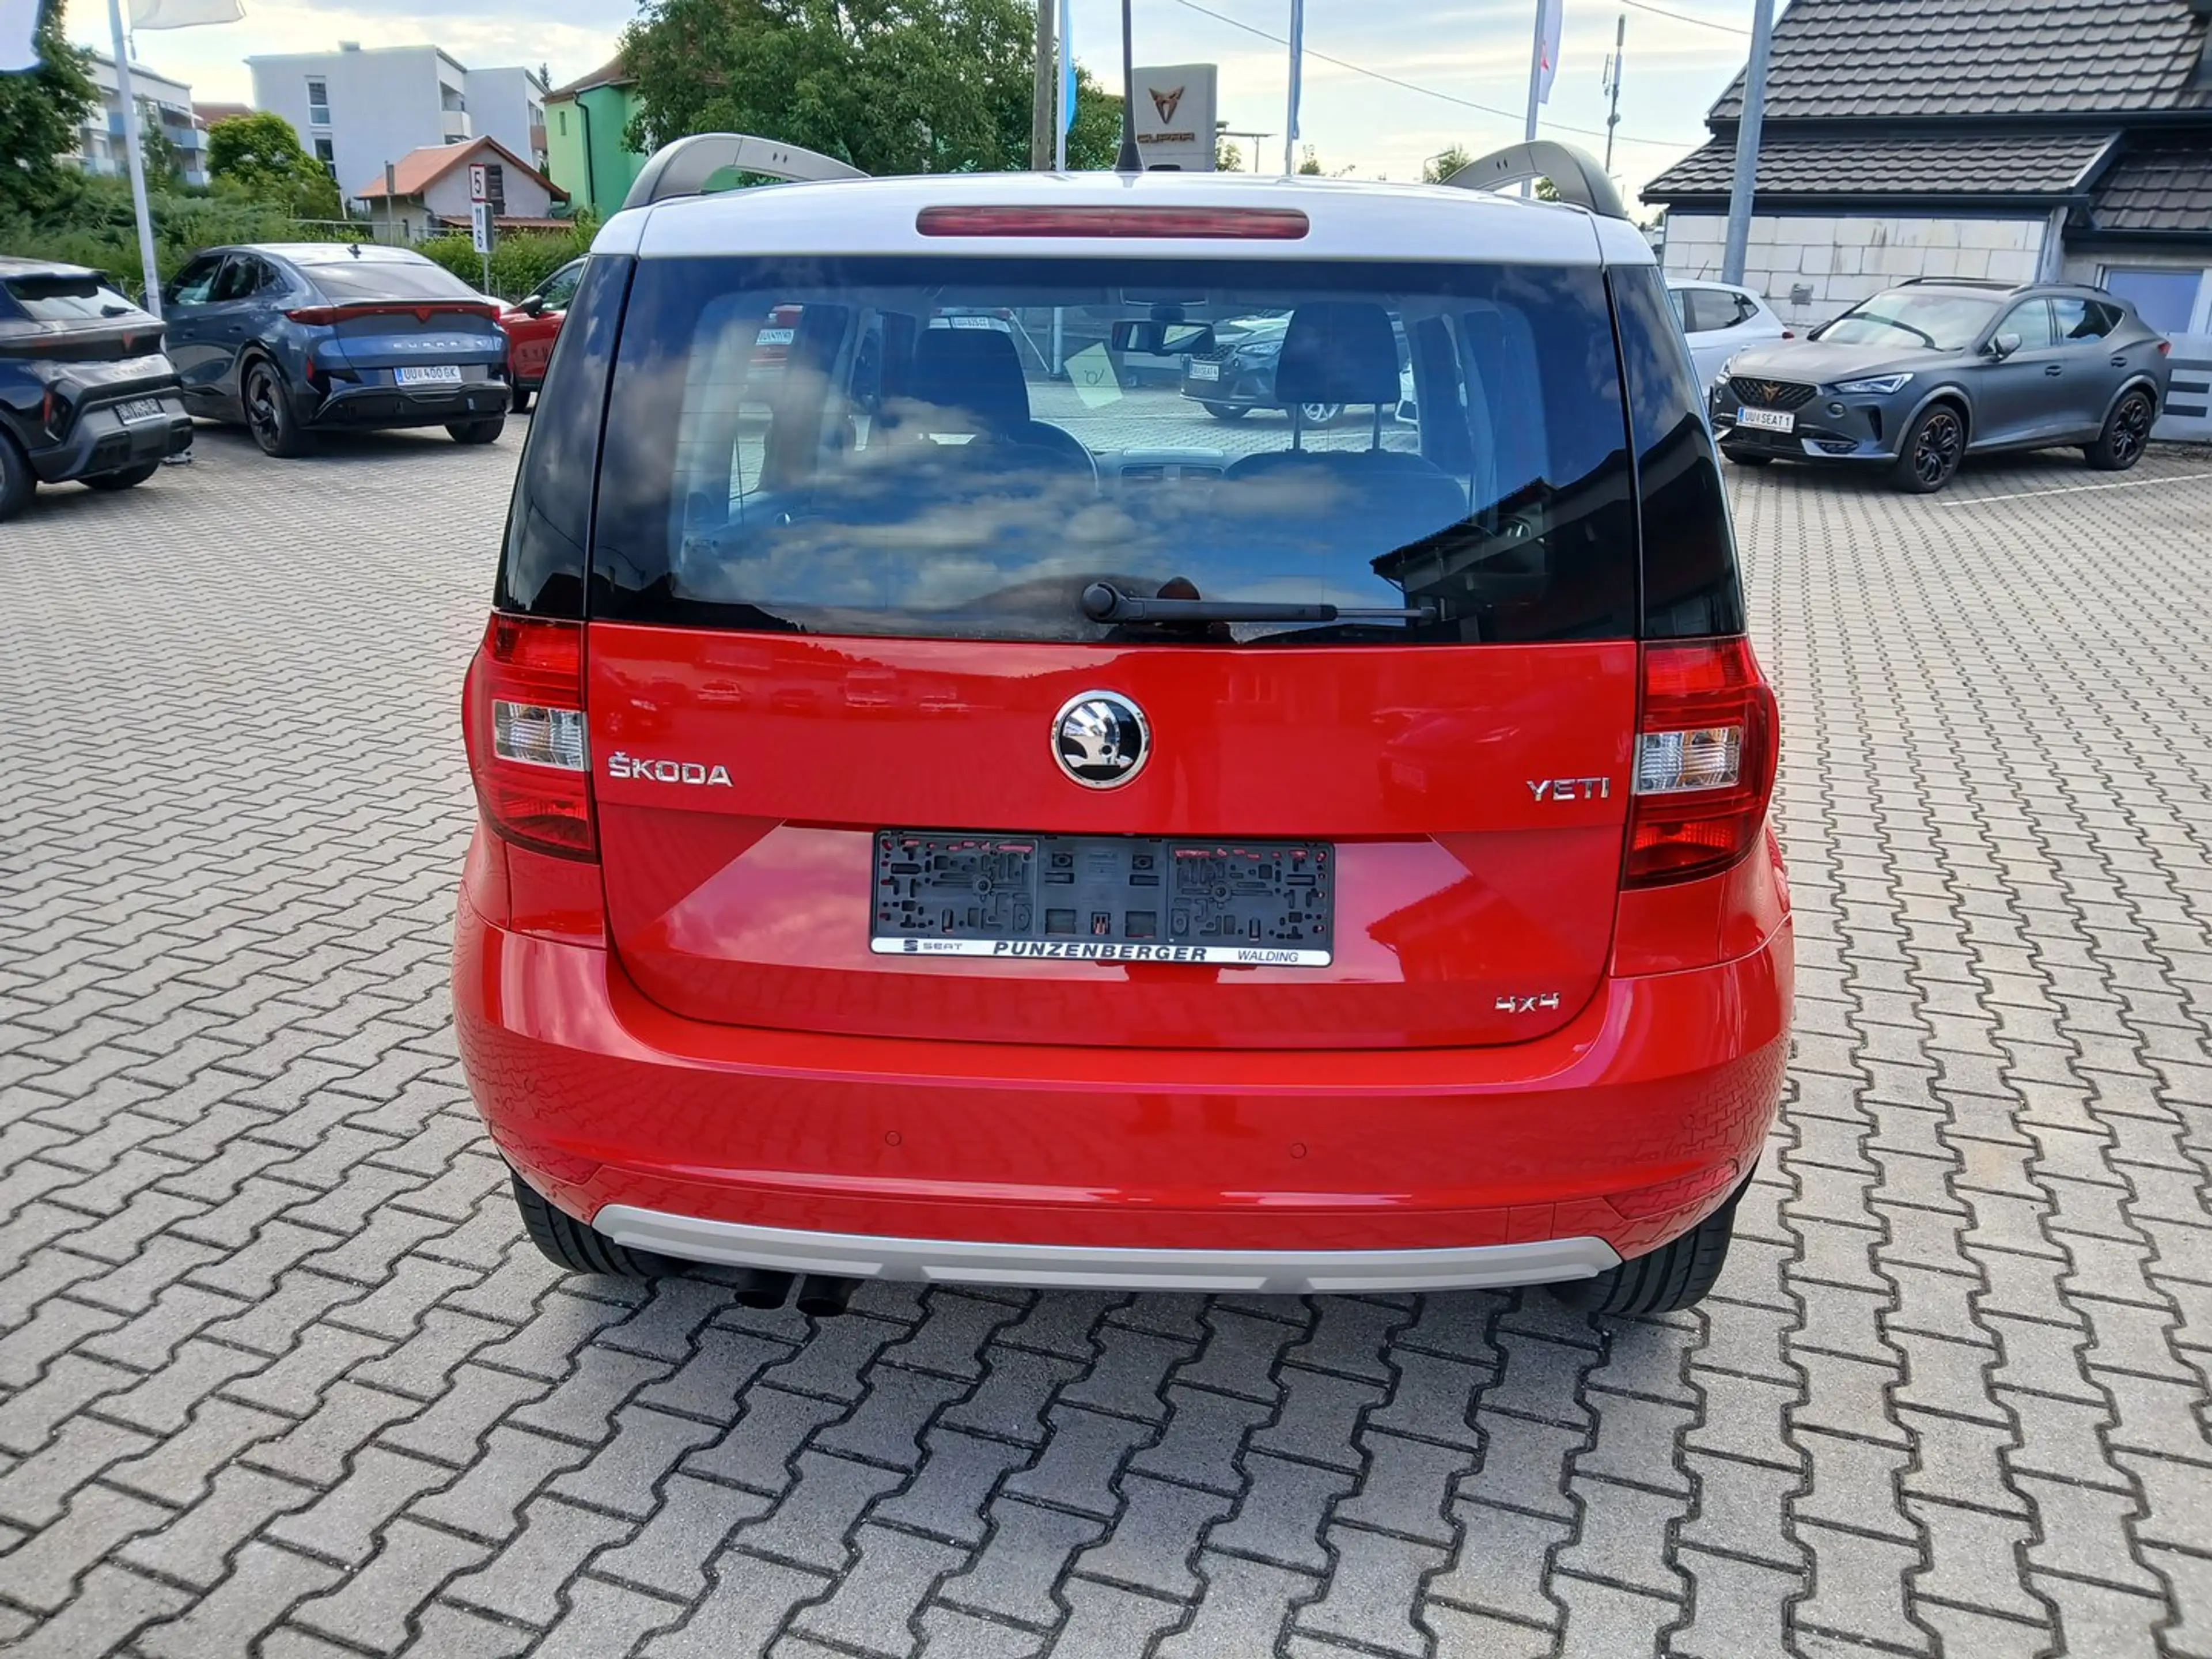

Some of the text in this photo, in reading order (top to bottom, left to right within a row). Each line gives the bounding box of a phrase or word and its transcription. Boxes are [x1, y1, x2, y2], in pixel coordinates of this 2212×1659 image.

[474, 171, 482, 195] 5
[476, 230, 483, 248] 6
[1762, 413, 1783, 426] SEAT
[608, 751, 733, 787] ŠKODA
[1527, 777, 1609, 802] YETI
[923, 942, 1299, 963] SEAT PUNZENBERGER WALDING
